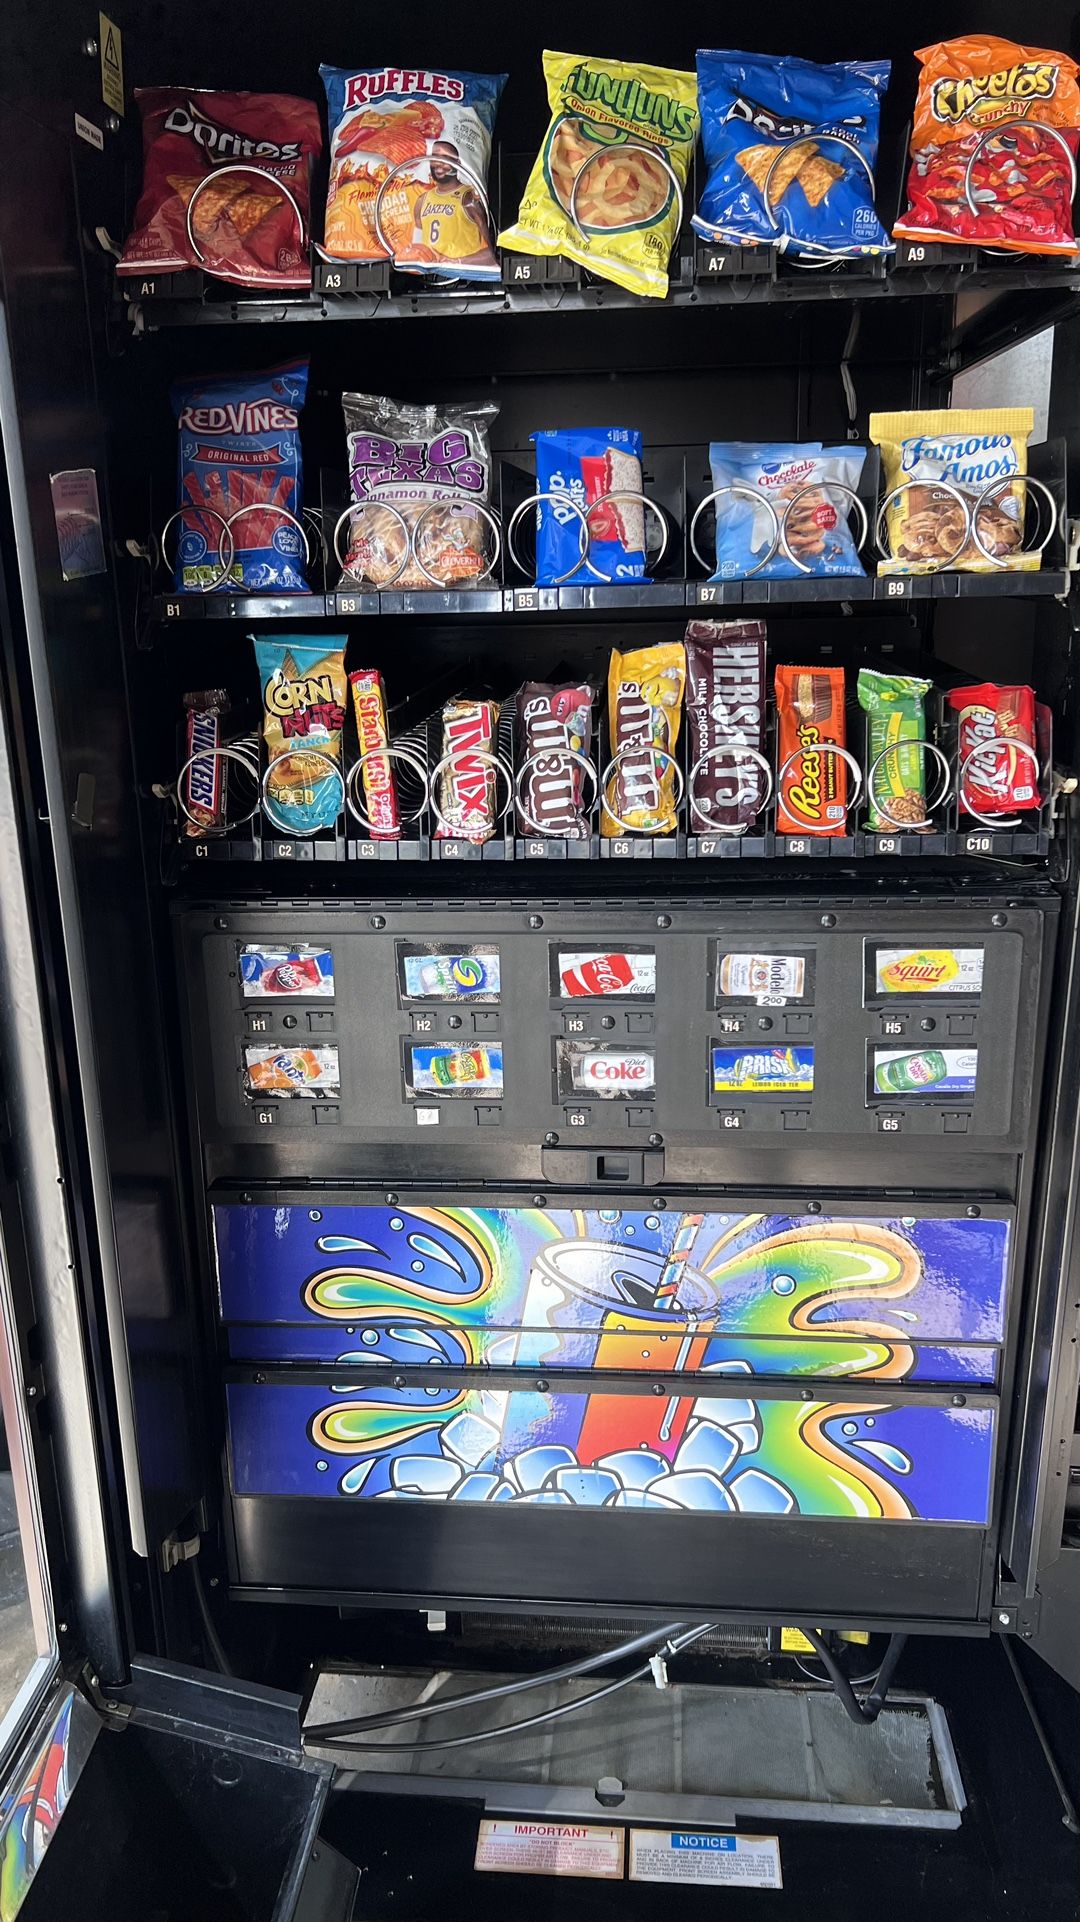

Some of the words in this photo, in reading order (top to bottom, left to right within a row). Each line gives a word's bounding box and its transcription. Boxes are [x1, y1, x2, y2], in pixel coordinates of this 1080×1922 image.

[345, 68, 464, 110] RUFFLES
[932, 63, 1059, 124] Cheetos
[570, 98, 597, 118] Onion
[598, 113, 640, 133] Flavored
[642, 130, 669, 146] Rings
[164, 107, 300, 161] Doritos
[421, 202, 456, 218] LAKERS
[855, 209, 877, 223] 260
[429, 219, 441, 243] 6
[649, 234, 663, 250] 180
[908, 247, 925, 262] A9
[709, 257, 726, 271] A7
[514, 266, 531, 279] A5
[325, 274, 342, 287] A3
[141, 283, 155, 295] A1
[178, 406, 232, 434] RED
[225, 398, 298, 434] VINES
[351, 431, 470, 467] BIG
[901, 433, 1013, 472] Famous
[207, 450, 250, 463] ORIGINAL
[252, 453, 270, 462] RED
[758, 460, 818, 487] Chocolate
[939, 455, 1019, 484] Amos
[349, 459, 486, 500] TEXAS
[366, 489, 428, 502] innamon
[816, 508, 833, 518] SOFT
[615, 564, 634, 577] 2
[700, 588, 717, 601] B7
[888, 582, 905, 595] B9
[341, 599, 356, 612] B3
[518, 594, 534, 607] B5
[166, 604, 181, 617] B1
[264, 669, 333, 718] CORN
[698, 678, 708, 707] MILK
[713, 646, 761, 807] HERSHEY'S
[871, 717, 889, 753] VALLEY
[888, 731, 898, 779] CRUNHY
[788, 724, 822, 820] Reese's
[828, 806, 836, 818] 210
[196, 845, 208, 857] C1
[278, 845, 292, 856] C2
[361, 844, 375, 856] C3
[444, 845, 459, 856] C4
[530, 843, 544, 854] C5
[614, 842, 629, 853] C6
[701, 842, 716, 854] C7
[789, 840, 805, 852] C8
[879, 839, 895, 851] C9
[966, 838, 990, 851] C10
[770, 958, 787, 995] Modelo
[888, 961, 948, 982] Squirt
[629, 984, 646, 994] Coca
[252, 1020, 266, 1031] H1
[416, 1020, 431, 1031] H2
[568, 1020, 584, 1031] H3
[724, 1021, 740, 1032] H4
[885, 1022, 902, 1034] H5
[624, 1058, 647, 1066] Diet
[590, 1060, 646, 1080] Coke
[908, 1066, 921, 1080] DRY
[259, 1112, 273, 1124] G1
[570, 1115, 585, 1126] G3
[724, 1117, 740, 1128] G4
[882, 1120, 899, 1131] G5
[514, 1825, 589, 1838] IMPORTANT
[679, 1836, 728, 1849] NOTICE
